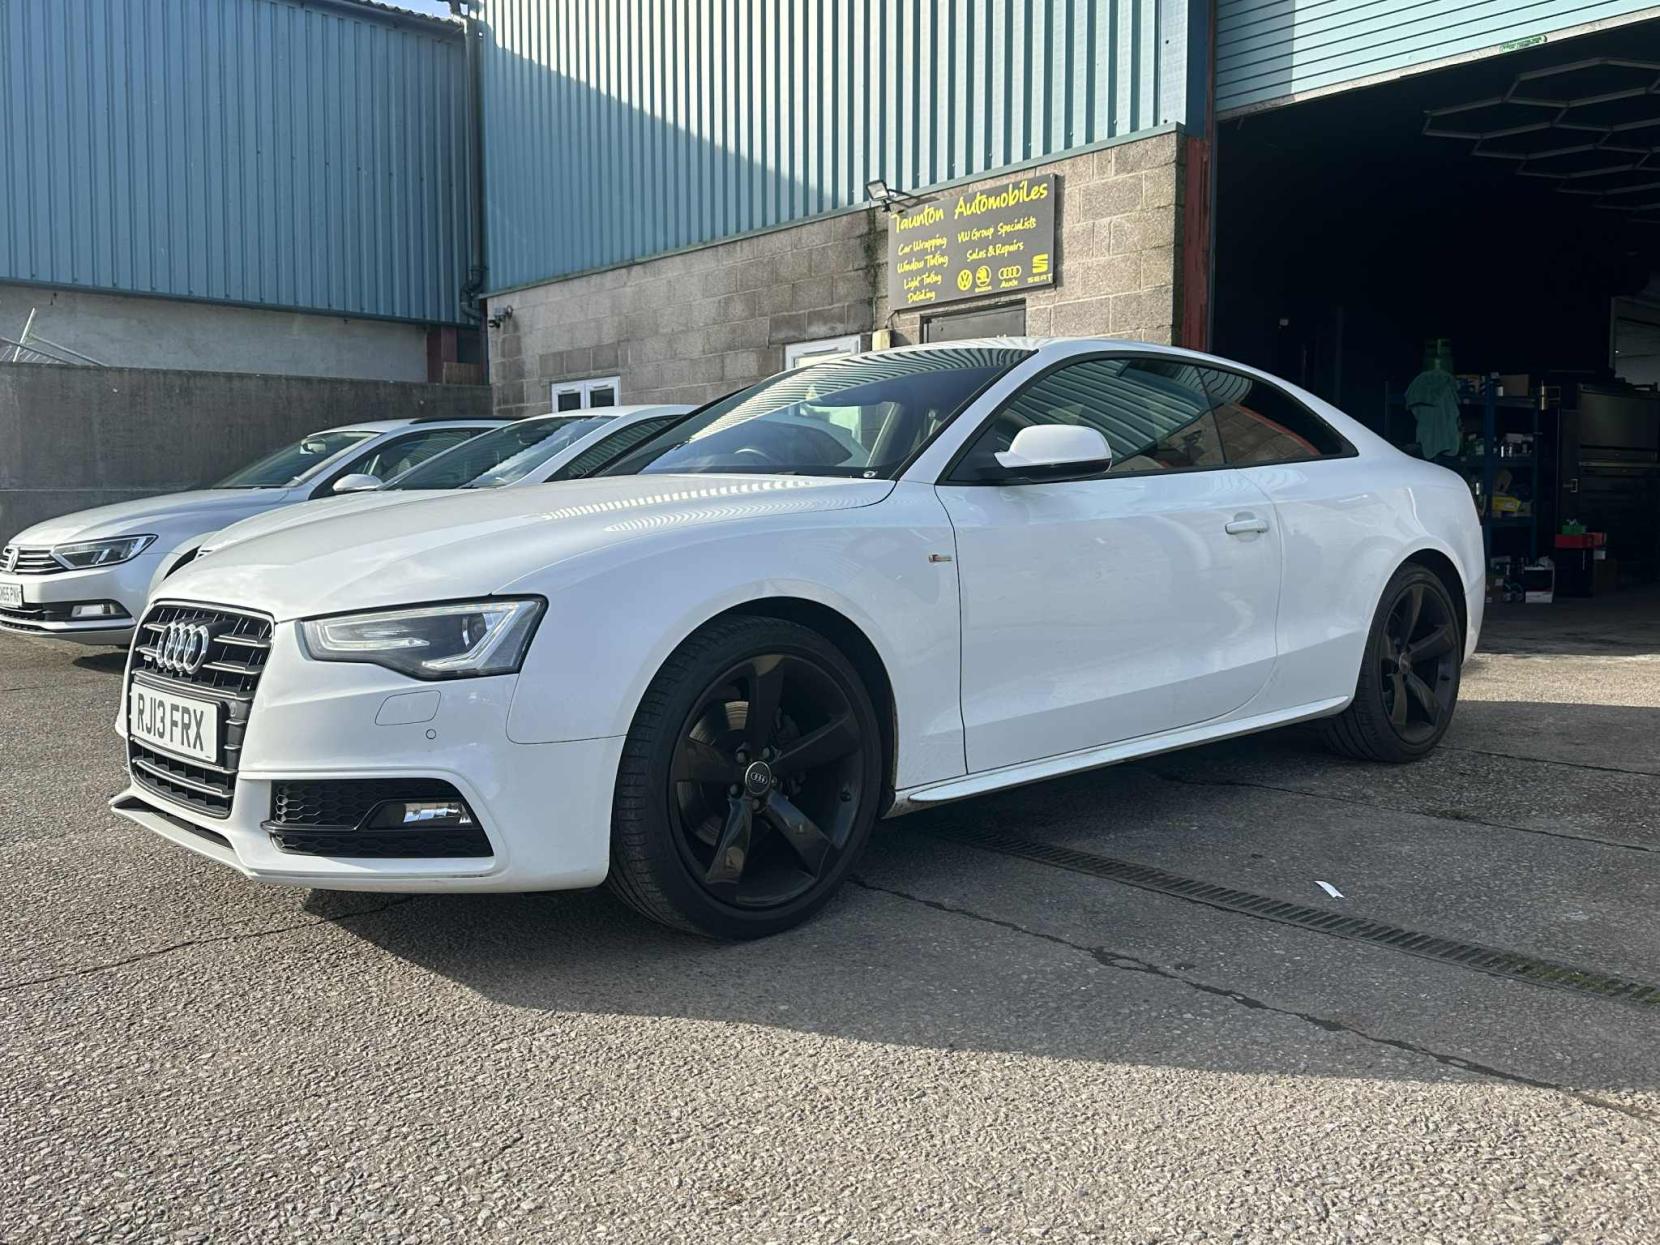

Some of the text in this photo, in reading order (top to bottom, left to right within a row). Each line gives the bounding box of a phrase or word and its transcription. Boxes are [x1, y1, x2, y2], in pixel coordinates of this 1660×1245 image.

[890, 180, 1048, 233] Taunton Automobiles
[971, 227, 994, 240] Group
[998, 216, 1036, 237] Specialists
[898, 235, 947, 255] Car Wrapping
[967, 237, 1024, 262] Sales & Repairs
[897, 257, 924, 273] Window
[903, 277, 921, 290] Light
[1000, 280, 1018, 288] Audi
[138, 692, 204, 752] RJ13 FRX
